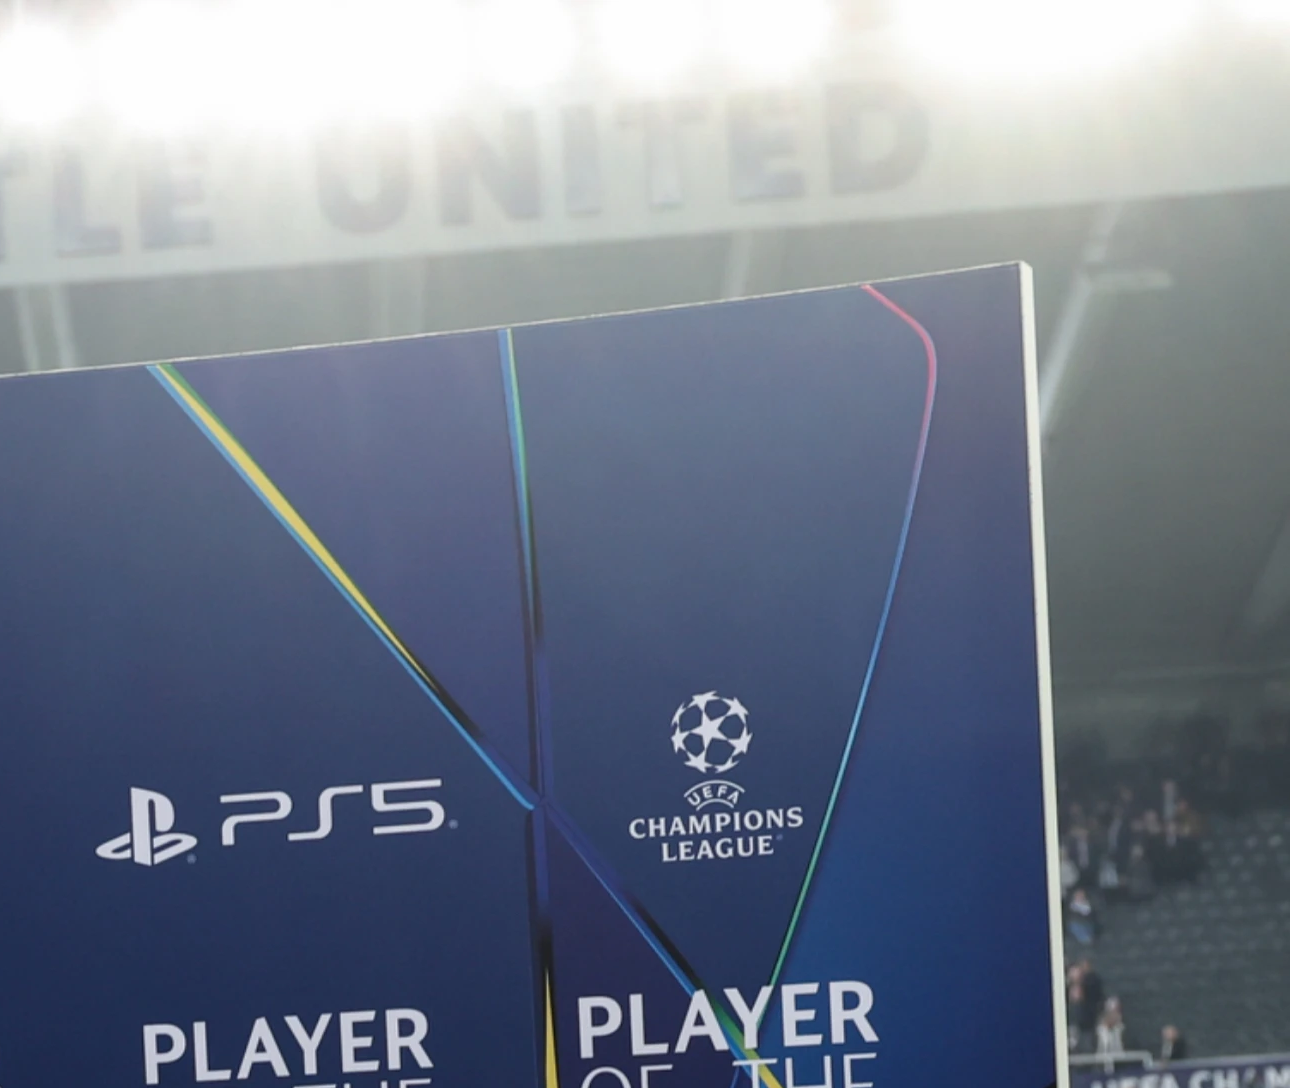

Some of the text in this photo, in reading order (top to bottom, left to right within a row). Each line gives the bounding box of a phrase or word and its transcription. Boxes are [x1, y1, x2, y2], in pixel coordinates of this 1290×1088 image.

[314, 80, 933, 235] UNITED
[220, 778, 446, 846] PS5
[628, 806, 804, 839] CHAMPIONS
[687, 784, 739, 806] UEFA
[661, 835, 775, 862] LEAGUE
[142, 1007, 435, 1085] PLAYER
[577, 980, 880, 1059] PLAYER
